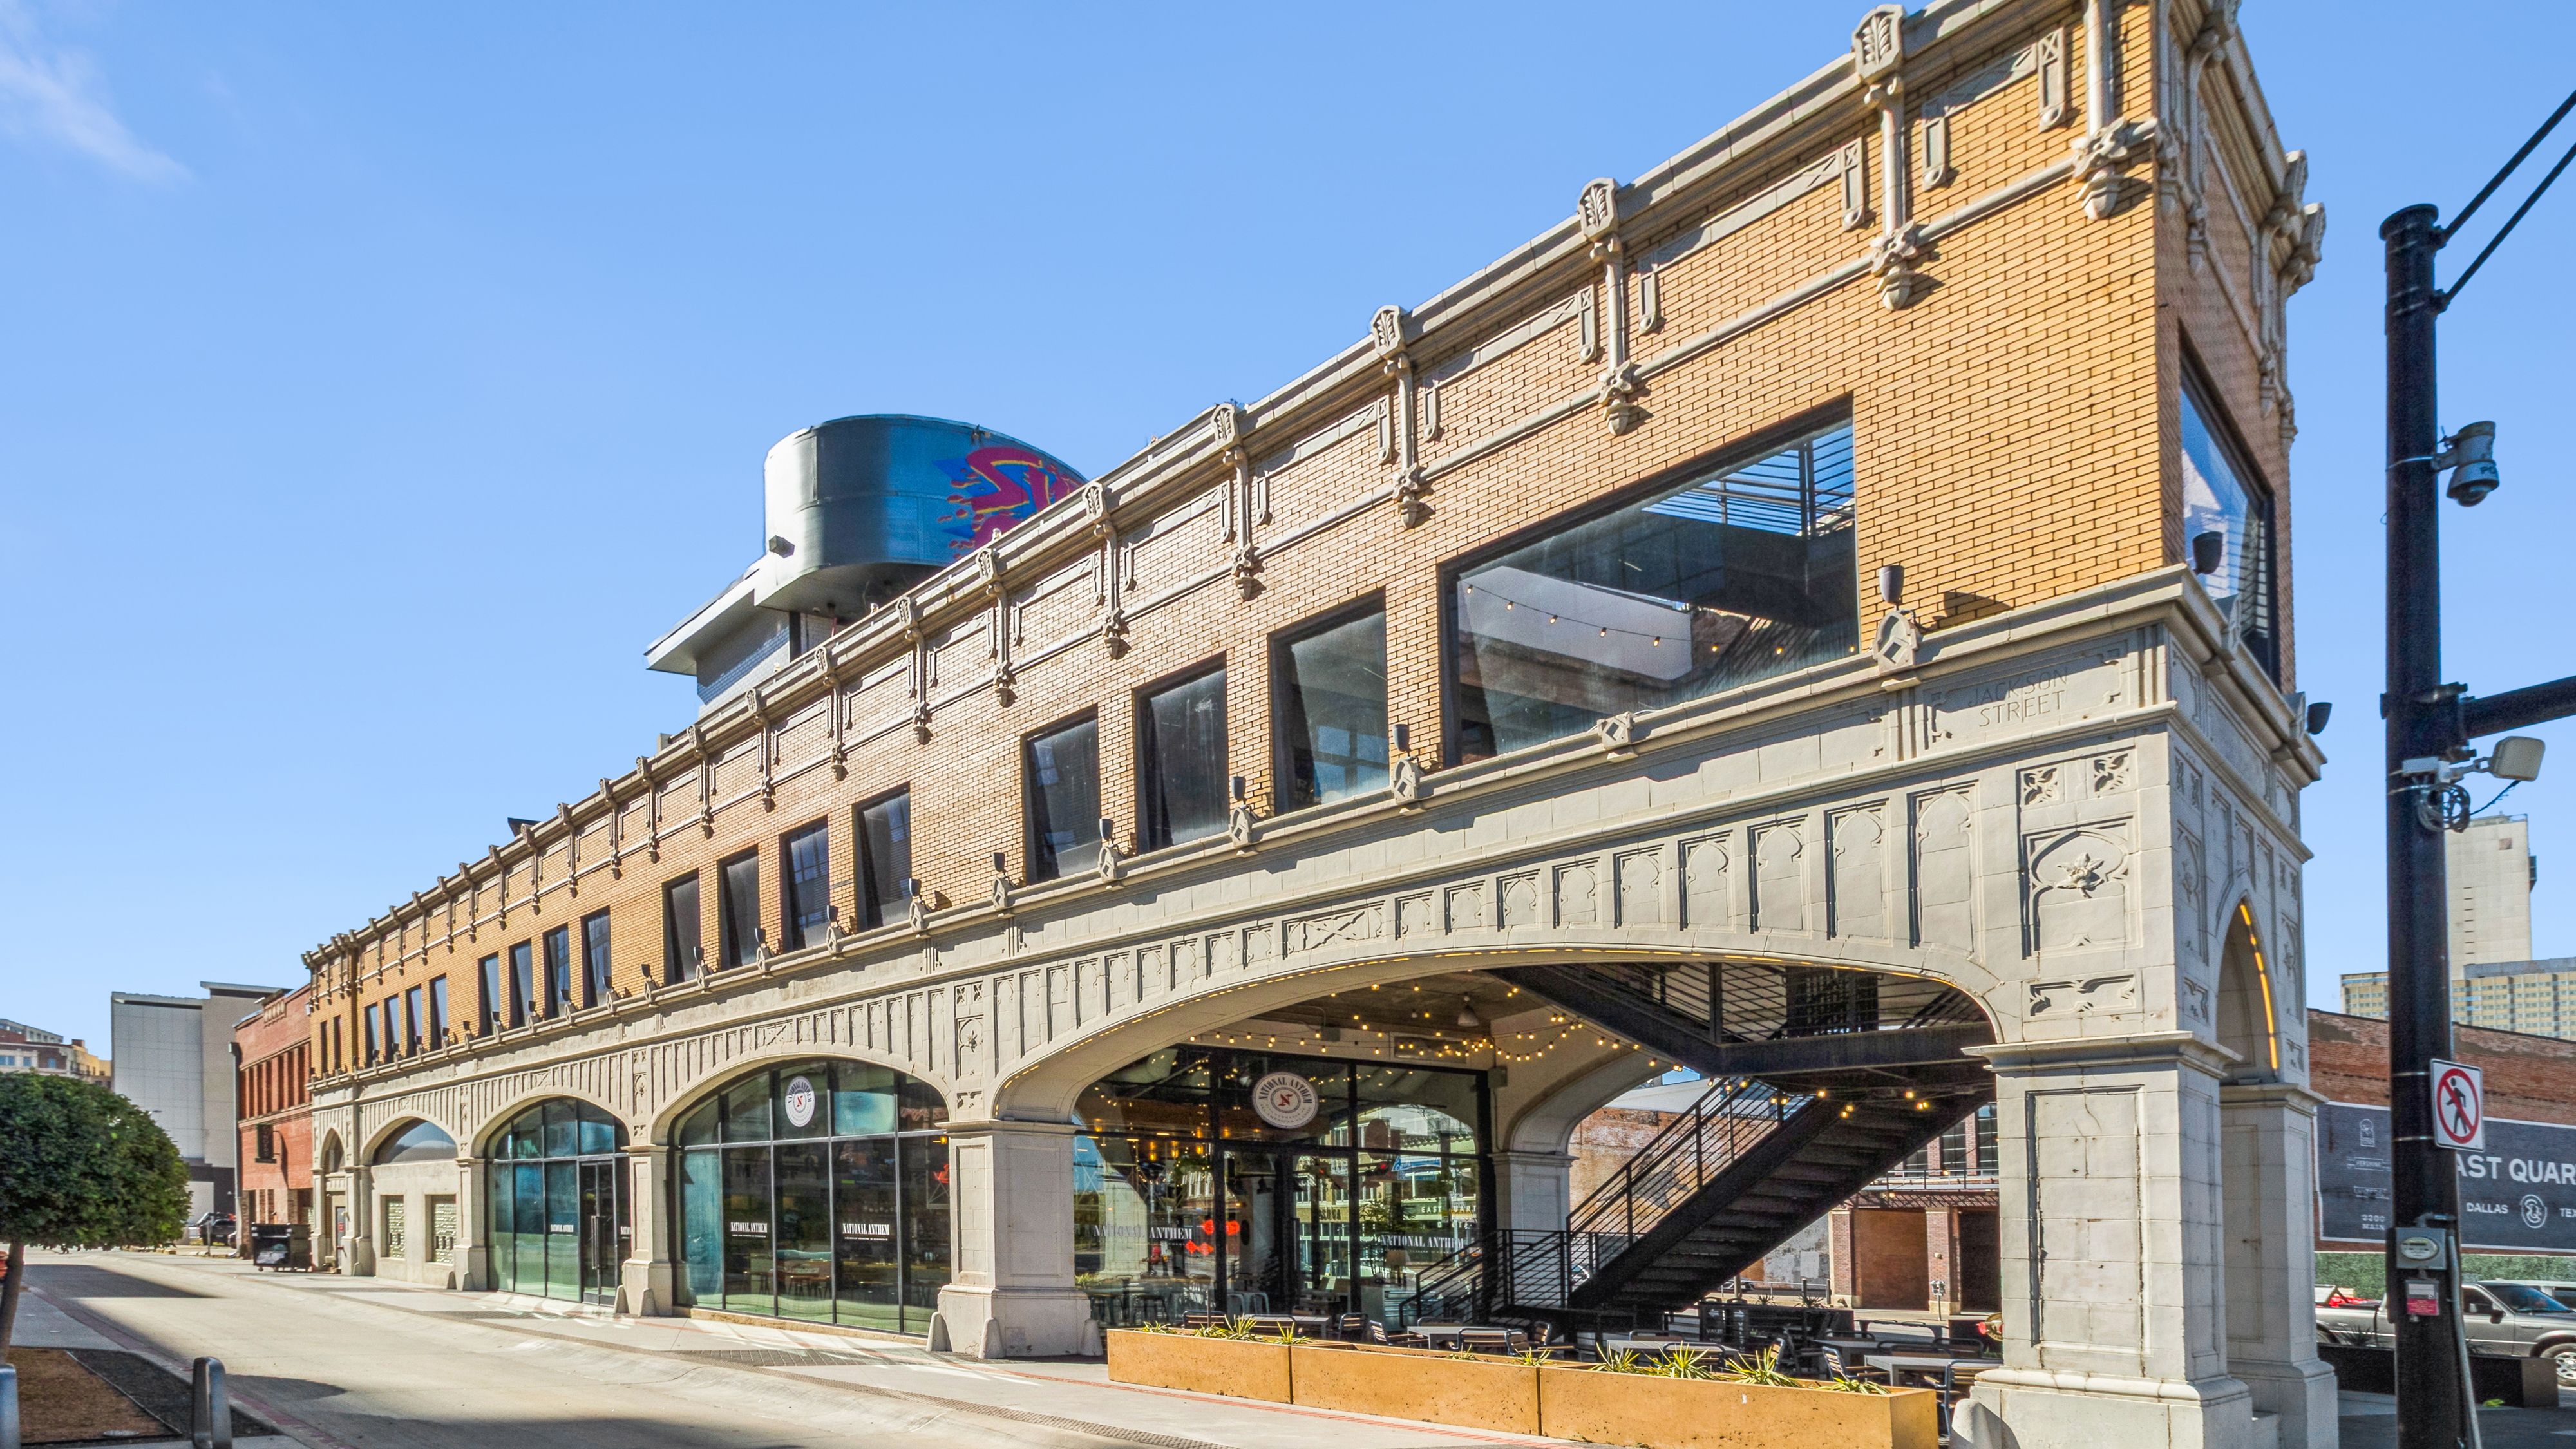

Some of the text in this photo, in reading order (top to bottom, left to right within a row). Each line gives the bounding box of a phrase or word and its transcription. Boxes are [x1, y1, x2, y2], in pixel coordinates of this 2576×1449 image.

[1968, 666, 2068, 707] JACKSON
[1978, 689, 2066, 727] STREET
[1258, 1077, 1312, 1103] NATIONAL ANTHEM
[2456, 1153, 2576, 1185] AST QUAR
[2466, 1202, 2508, 1214] DALLAS
[842, 1223, 889, 1235] NATIONAL ANTHEM
[1150, 1227, 1193, 1239] ANTHEM
[1381, 1235, 1425, 1247] NATIONAL
